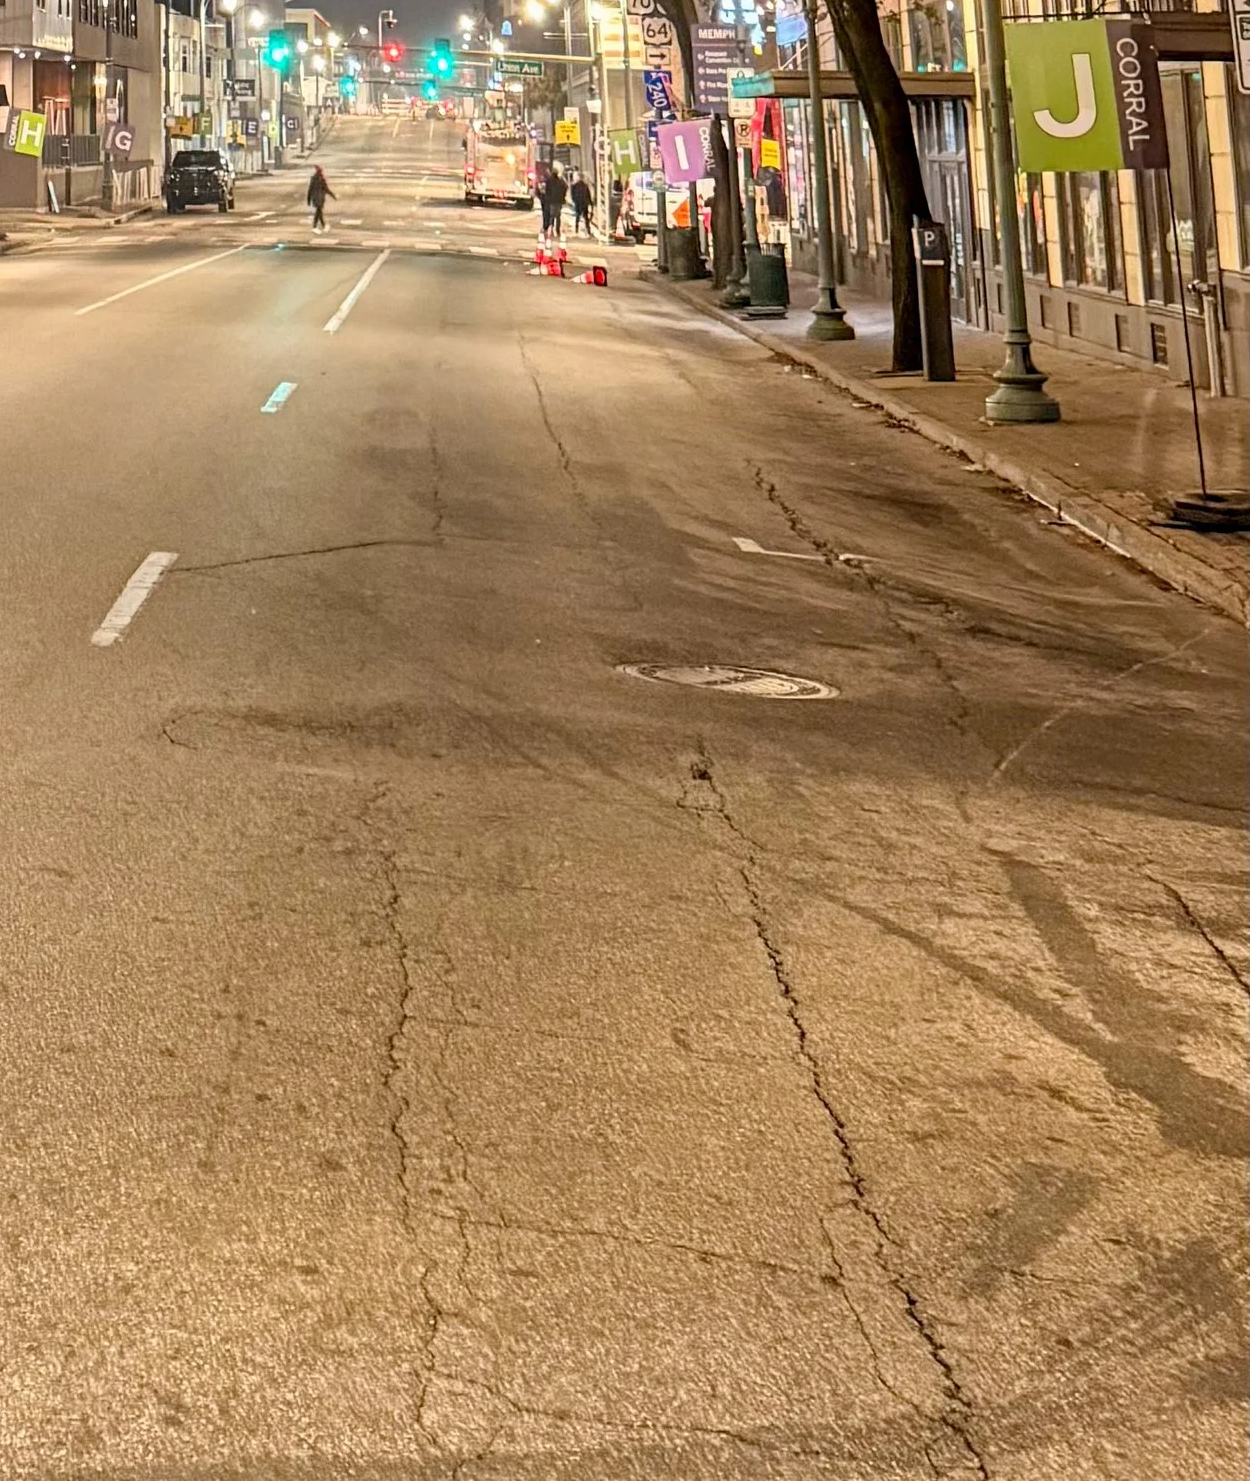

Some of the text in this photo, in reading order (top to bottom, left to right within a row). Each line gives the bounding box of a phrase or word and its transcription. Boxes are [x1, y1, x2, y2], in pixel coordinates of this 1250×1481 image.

[646, 22, 668, 38] 64
[648, 81, 668, 107] 240
[1034, 53, 1097, 138] J
[1116, 37, 1150, 151] CORRAL
[20, 120, 43, 147] H
[247, 121, 258, 134] E
[115, 131, 132, 151] G
[613, 140, 637, 166] H
[674, 135, 689, 170] I
[699, 126, 716, 172] CORRAL
[923, 230, 936, 247] P
